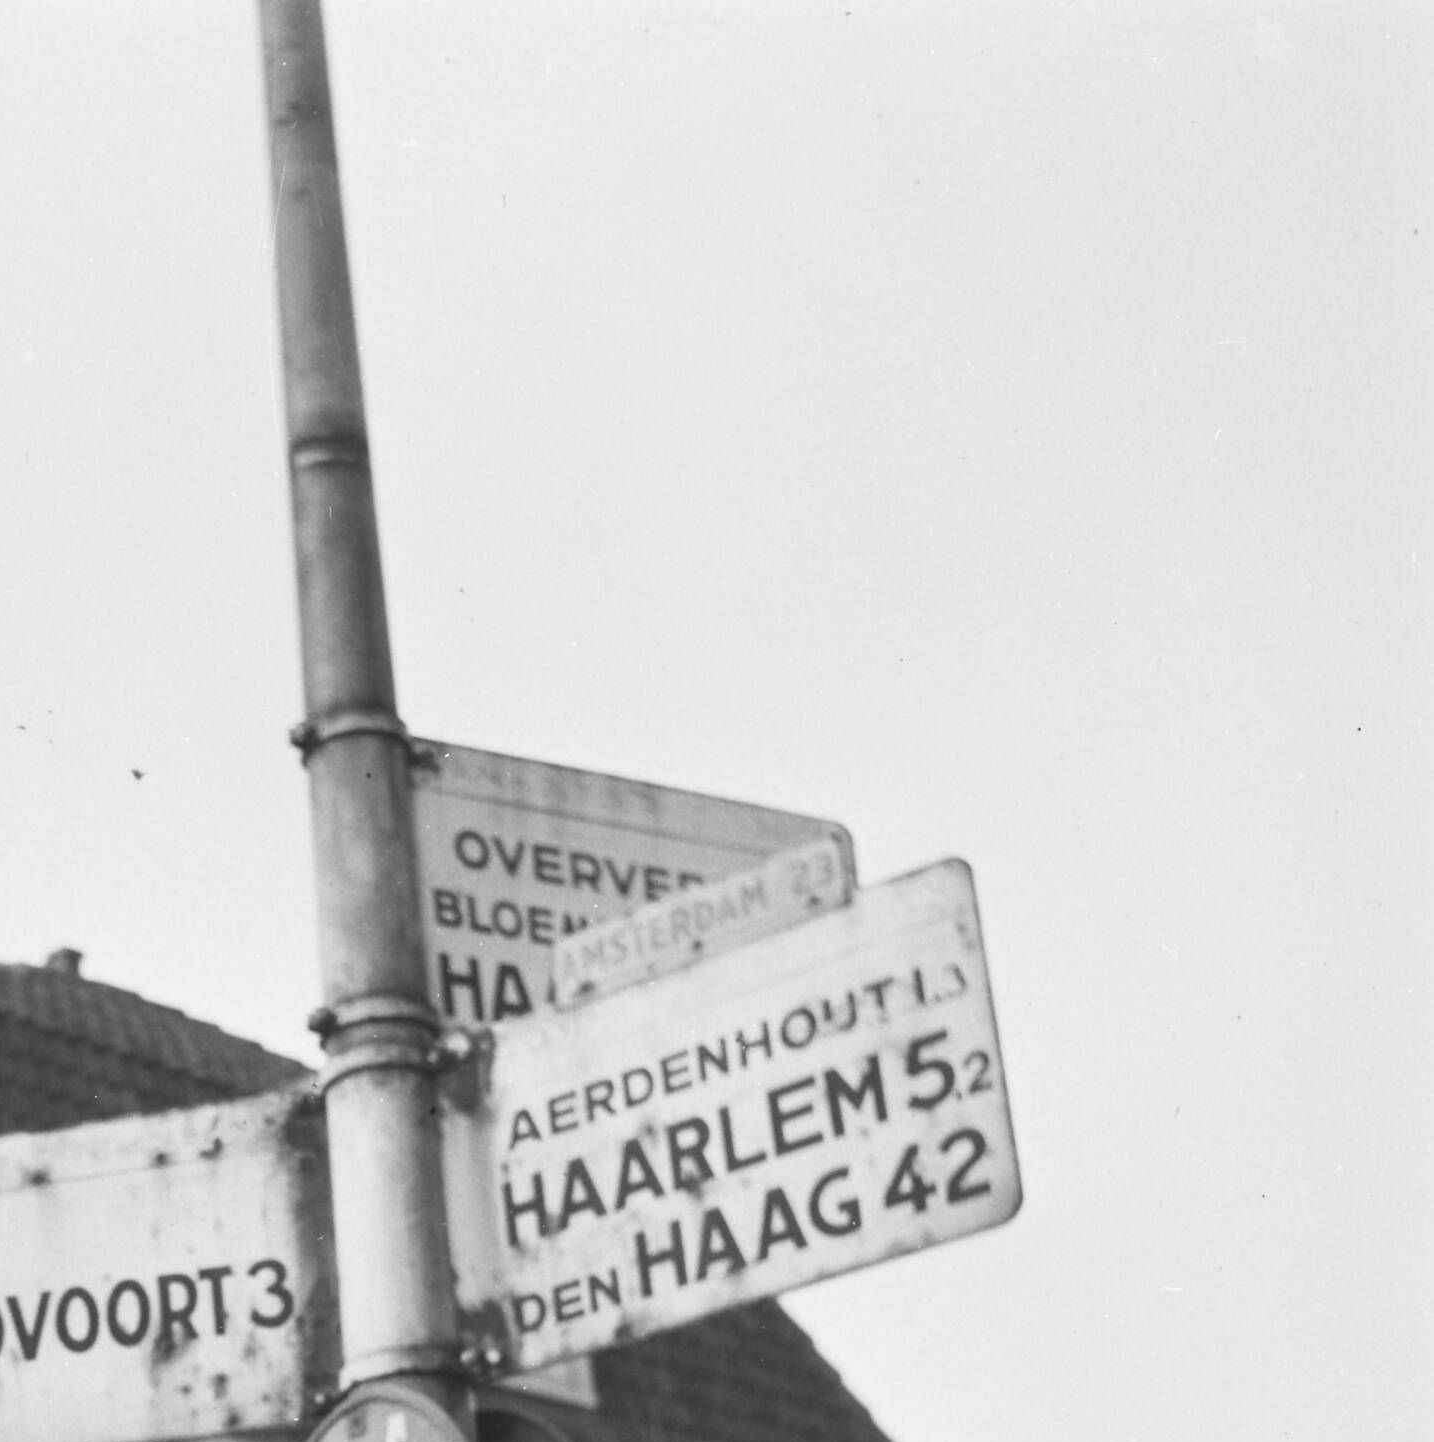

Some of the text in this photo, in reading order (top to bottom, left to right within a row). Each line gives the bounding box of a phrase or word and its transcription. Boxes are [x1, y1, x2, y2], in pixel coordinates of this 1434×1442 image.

[438, 951, 557, 1022] HA
[508, 975, 895, 1150] AERDENHOUT
[502, 1054, 888, 1248] HAARLEM
[511, 1127, 993, 1335] DEN HAAG 42
[247, 1259, 295, 1329] 3
